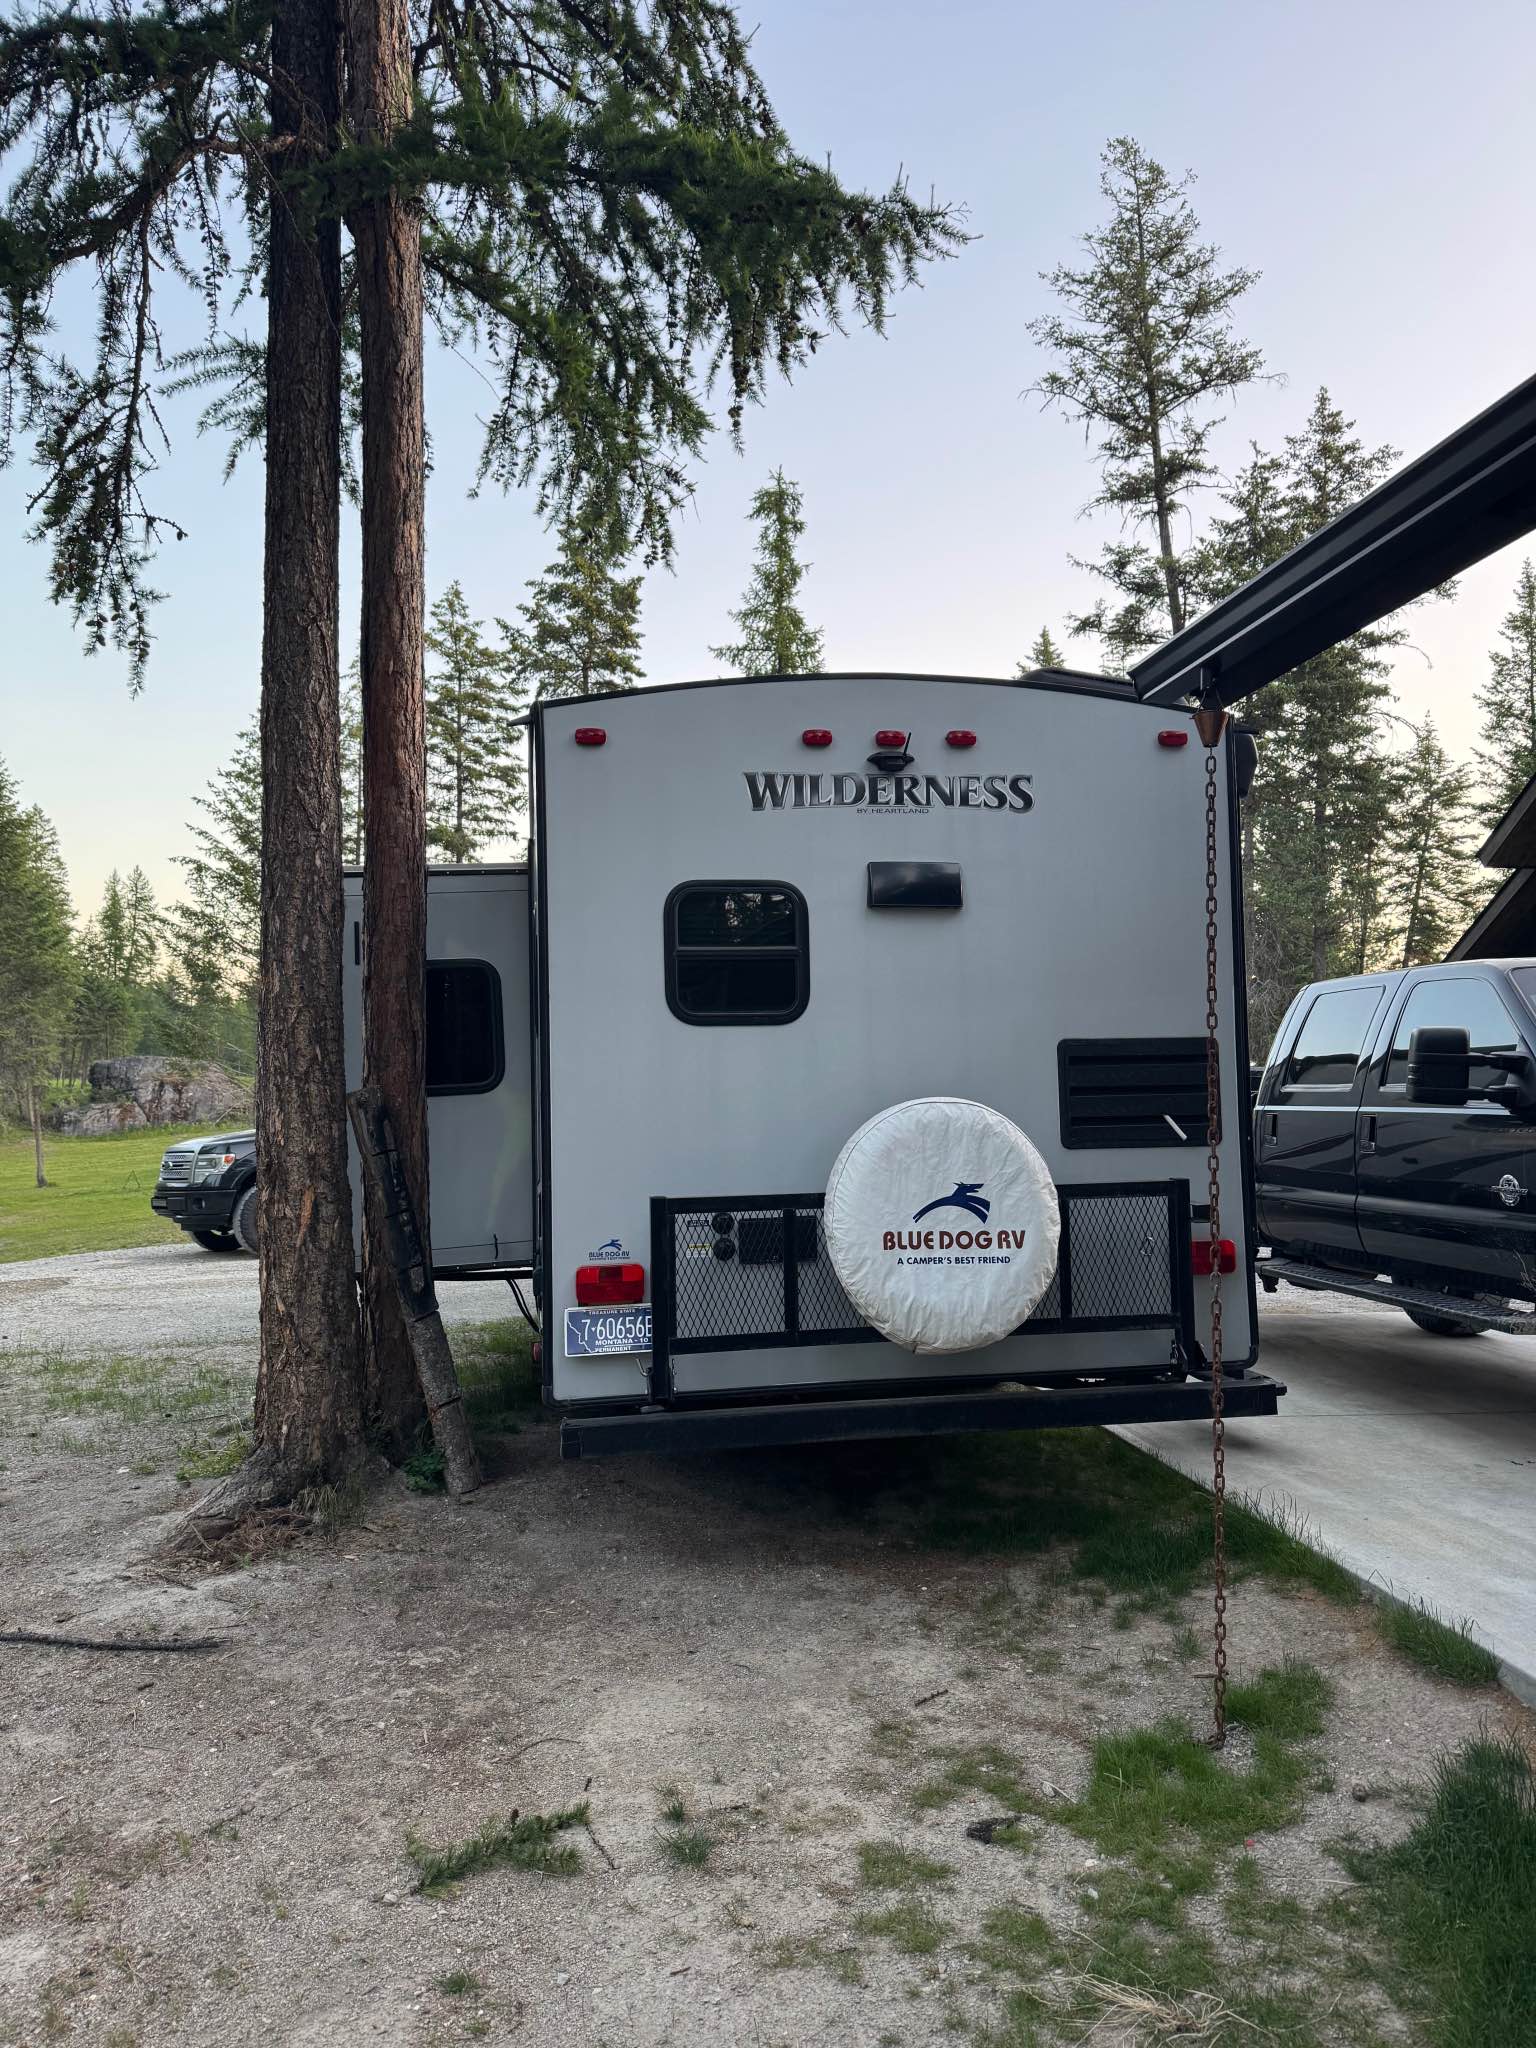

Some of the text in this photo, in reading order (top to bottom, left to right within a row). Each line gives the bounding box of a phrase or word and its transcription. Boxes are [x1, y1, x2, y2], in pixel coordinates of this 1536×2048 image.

[743, 772, 1035, 813] WILDERNESS
[882, 1230, 1026, 1250] BLUE DOG RV
[897, 1256, 1011, 1265] A CAMPER'S BEST FRIEND
[595, 1338, 633, 1346] MONTANA
